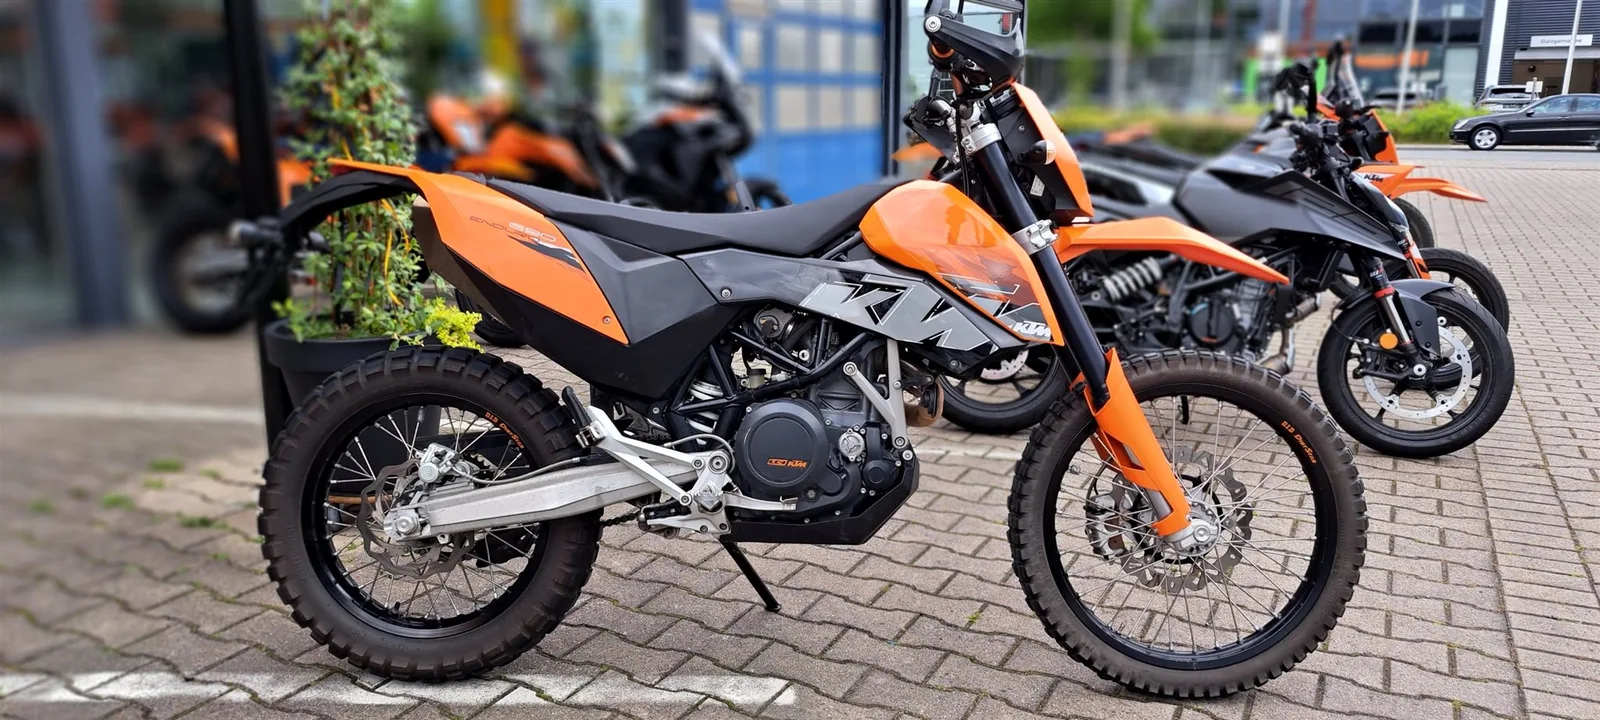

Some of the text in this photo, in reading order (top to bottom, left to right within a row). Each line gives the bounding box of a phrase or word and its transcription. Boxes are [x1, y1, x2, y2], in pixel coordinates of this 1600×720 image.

[1364, 174, 1383, 182] KTM
[470, 216, 540, 243] ENDURO
[509, 222, 556, 242] 690
[1013, 321, 1051, 337] KTM
[787, 460, 807, 468] KTM
